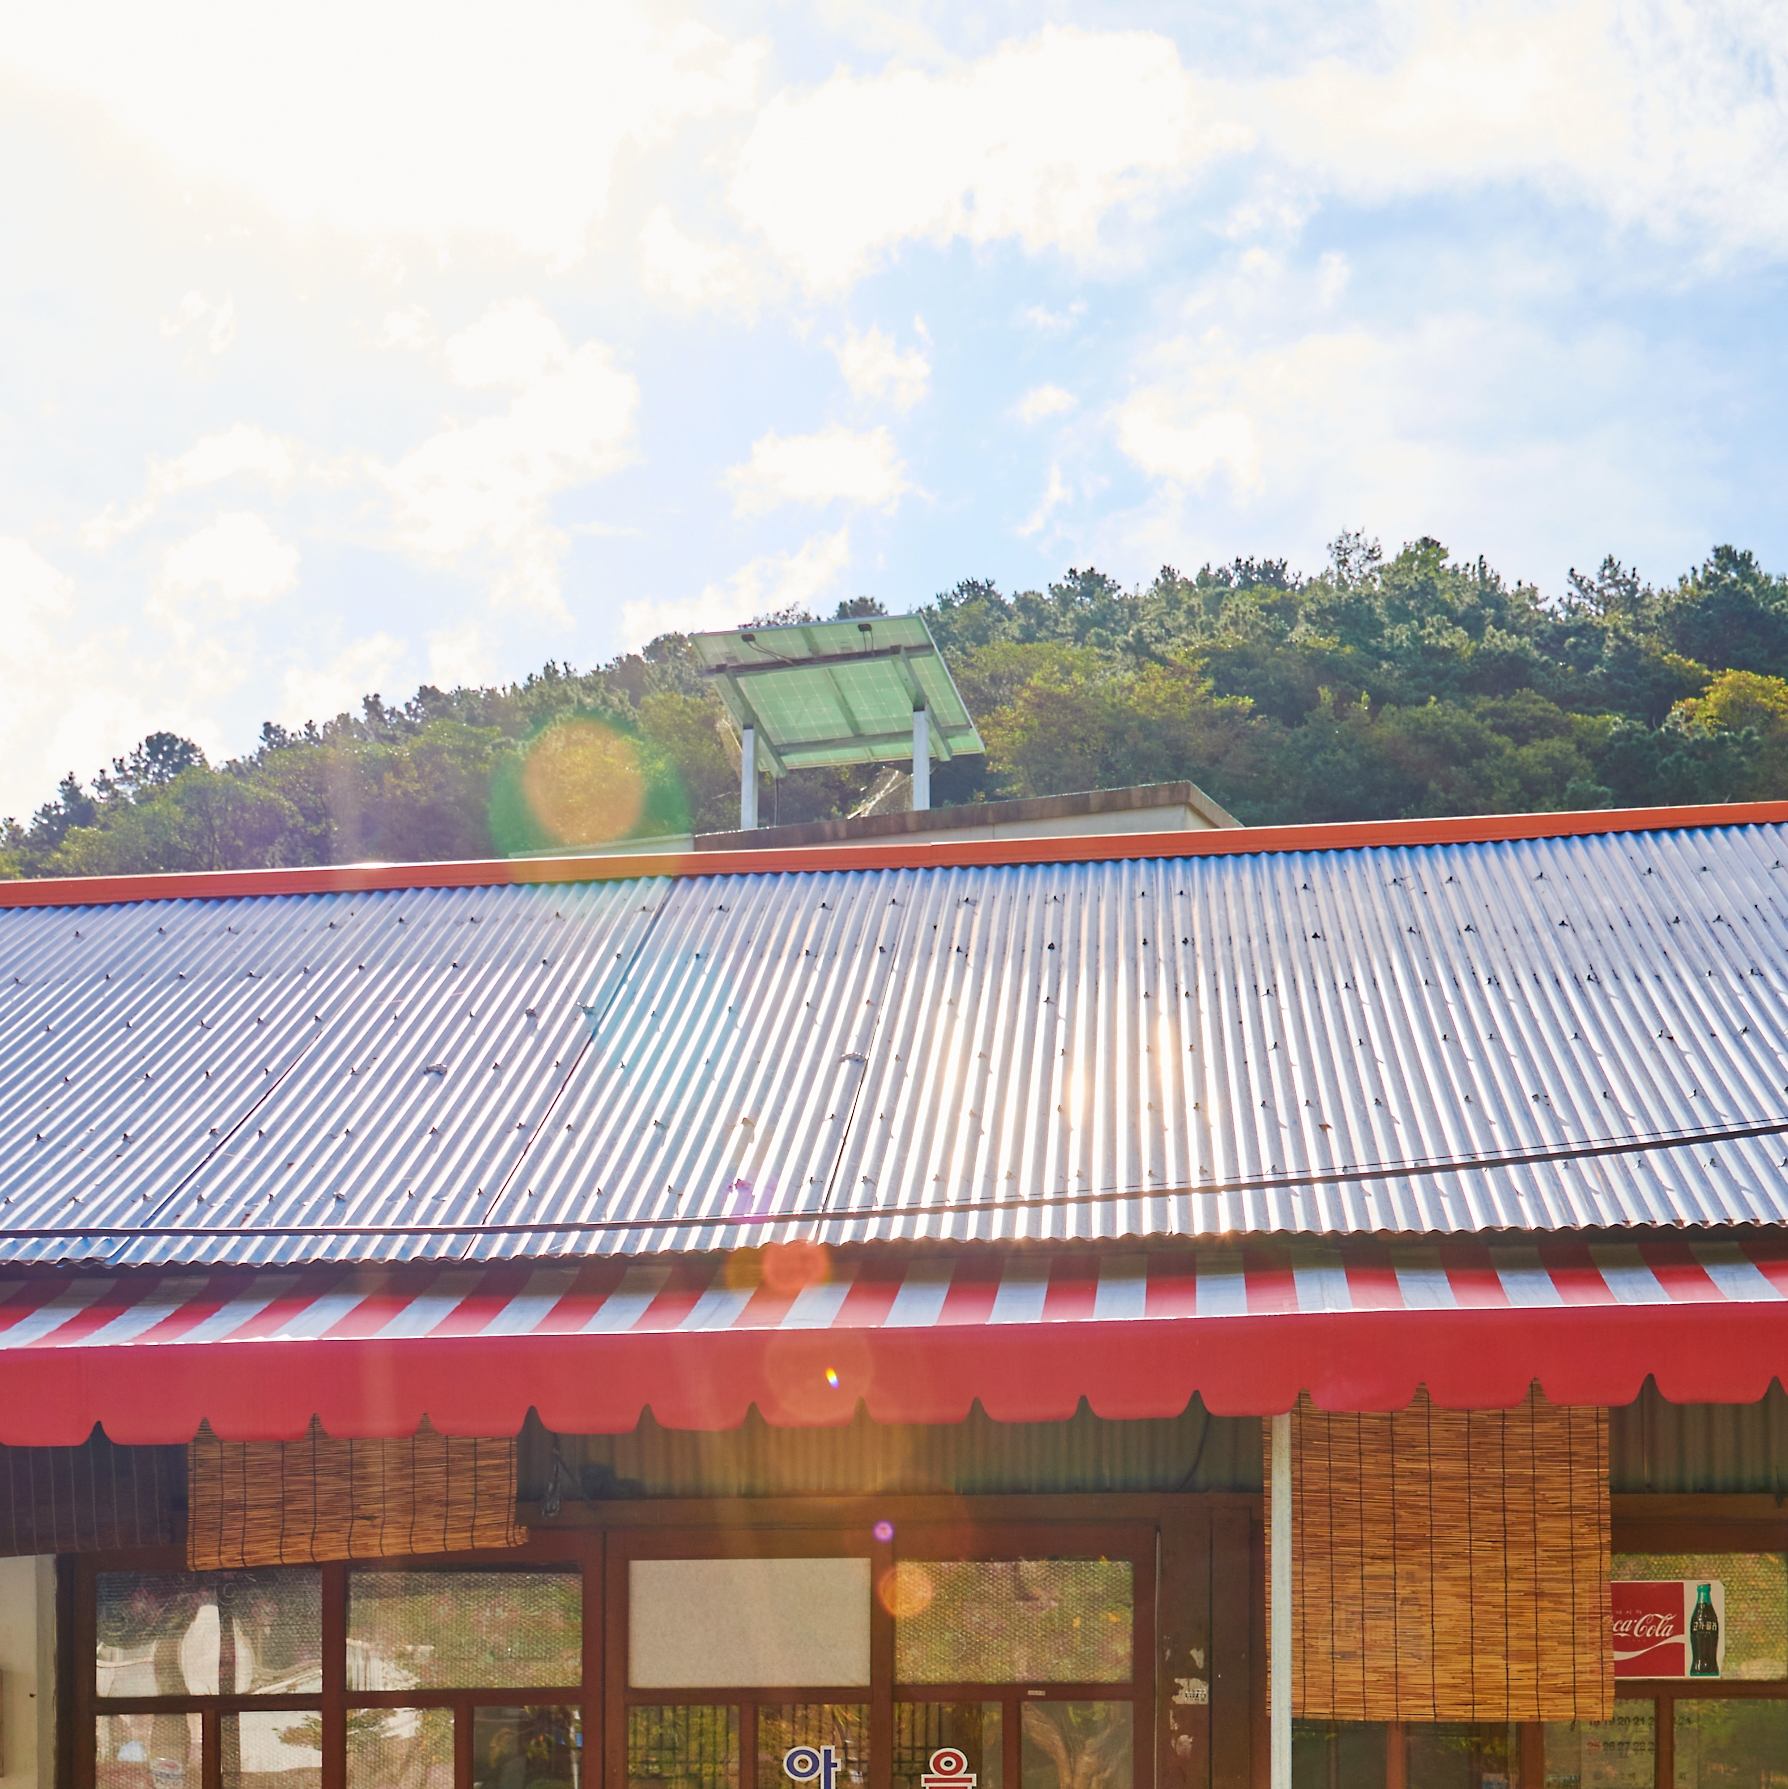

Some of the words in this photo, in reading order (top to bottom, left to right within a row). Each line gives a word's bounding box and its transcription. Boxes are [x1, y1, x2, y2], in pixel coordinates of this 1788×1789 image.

[1612, 1613, 1677, 1637] ca-Cola
[1617, 1716, 1631, 1726] 20
[1633, 1716, 1645, 1726] 21
[1617, 1741, 1631, 1751] 27
